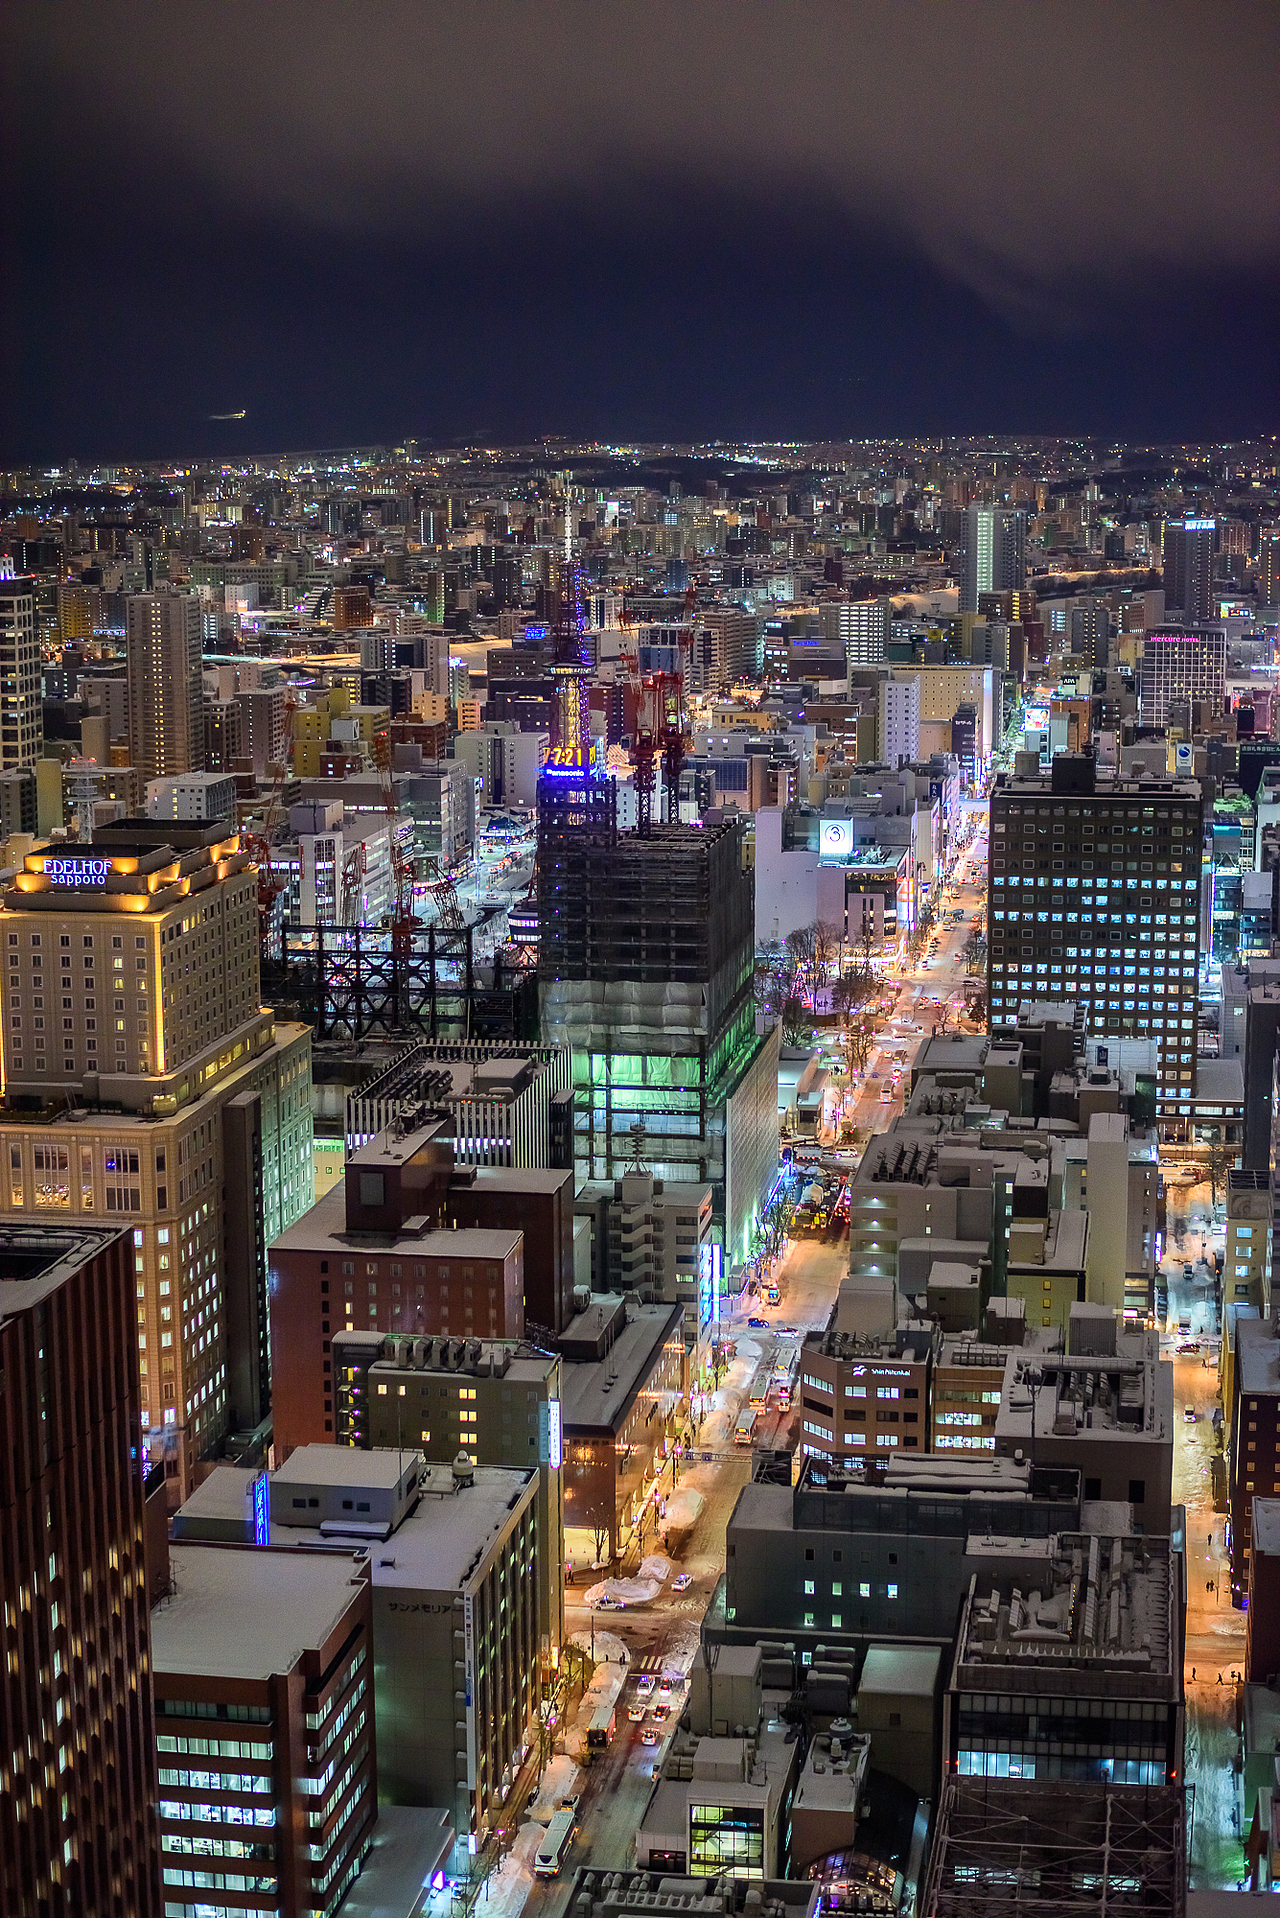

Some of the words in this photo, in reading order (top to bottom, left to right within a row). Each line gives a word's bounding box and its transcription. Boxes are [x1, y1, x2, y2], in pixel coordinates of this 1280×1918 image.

[546, 768, 585, 777] Panasonic
[43, 859, 112, 875] EDELHOF
[50, 874, 105, 886] sapporo
[389, 1602, 452, 1614] サンメモリア
